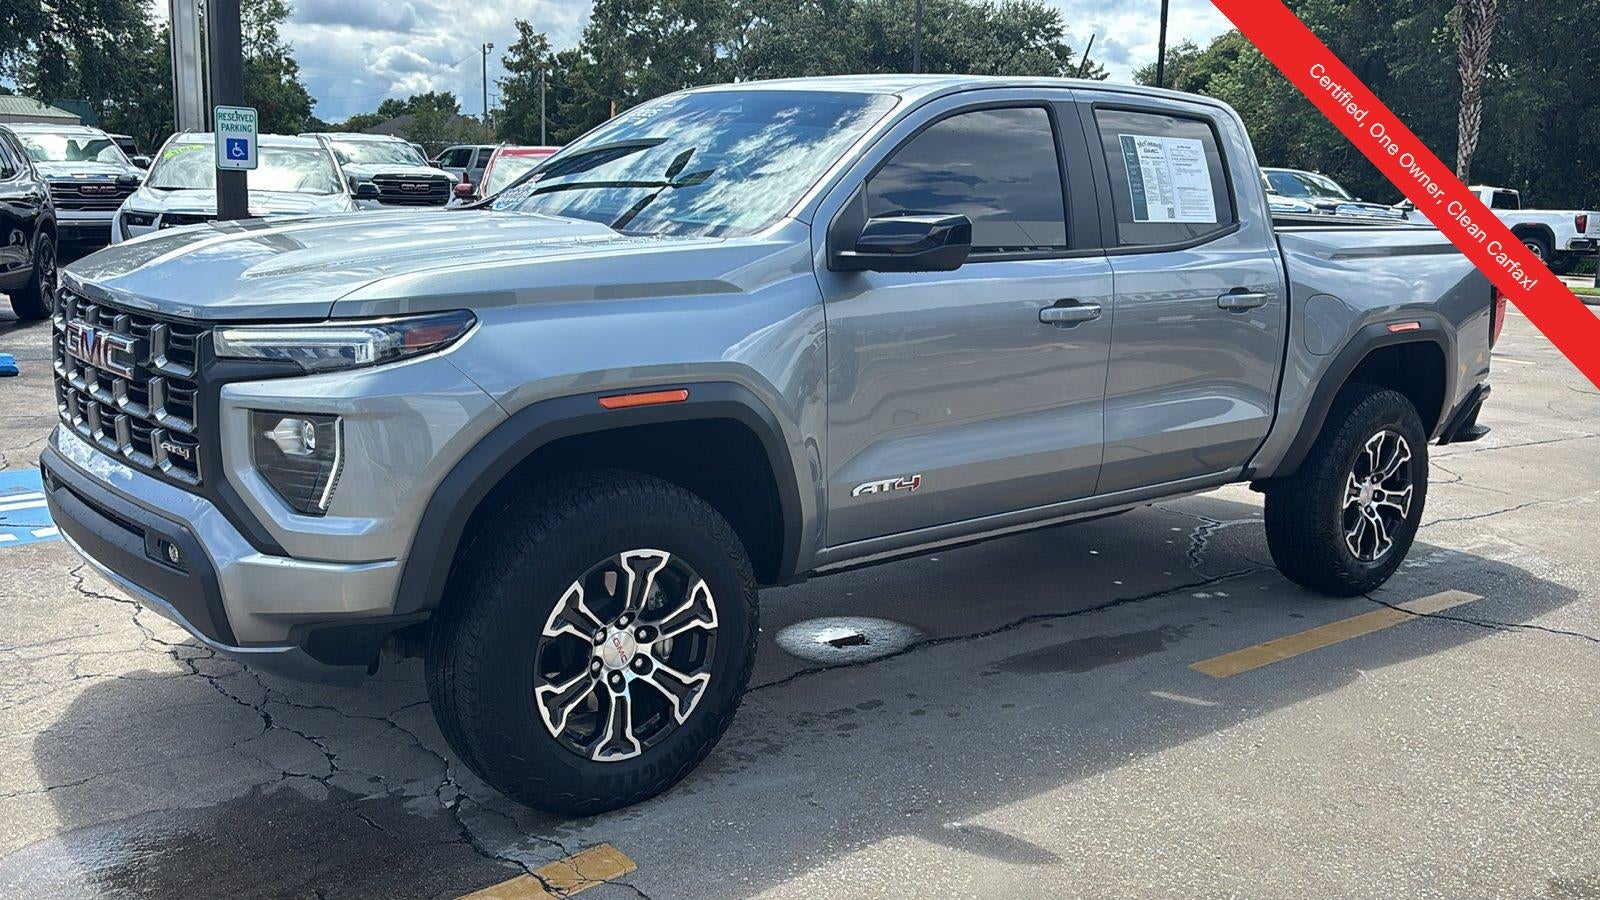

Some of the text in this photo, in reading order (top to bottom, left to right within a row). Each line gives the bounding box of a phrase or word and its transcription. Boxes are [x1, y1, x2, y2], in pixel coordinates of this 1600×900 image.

[217, 112, 255, 122] RESERVED
[221, 123, 253, 133] PARKING
[81, 185, 117, 193] GMC
[401, 183, 430, 191] GMC
[65, 319, 135, 380] GMC
[160, 441, 190, 460] AT4
[850, 474, 922, 498] AT4
[612, 637, 628, 664] GMC
